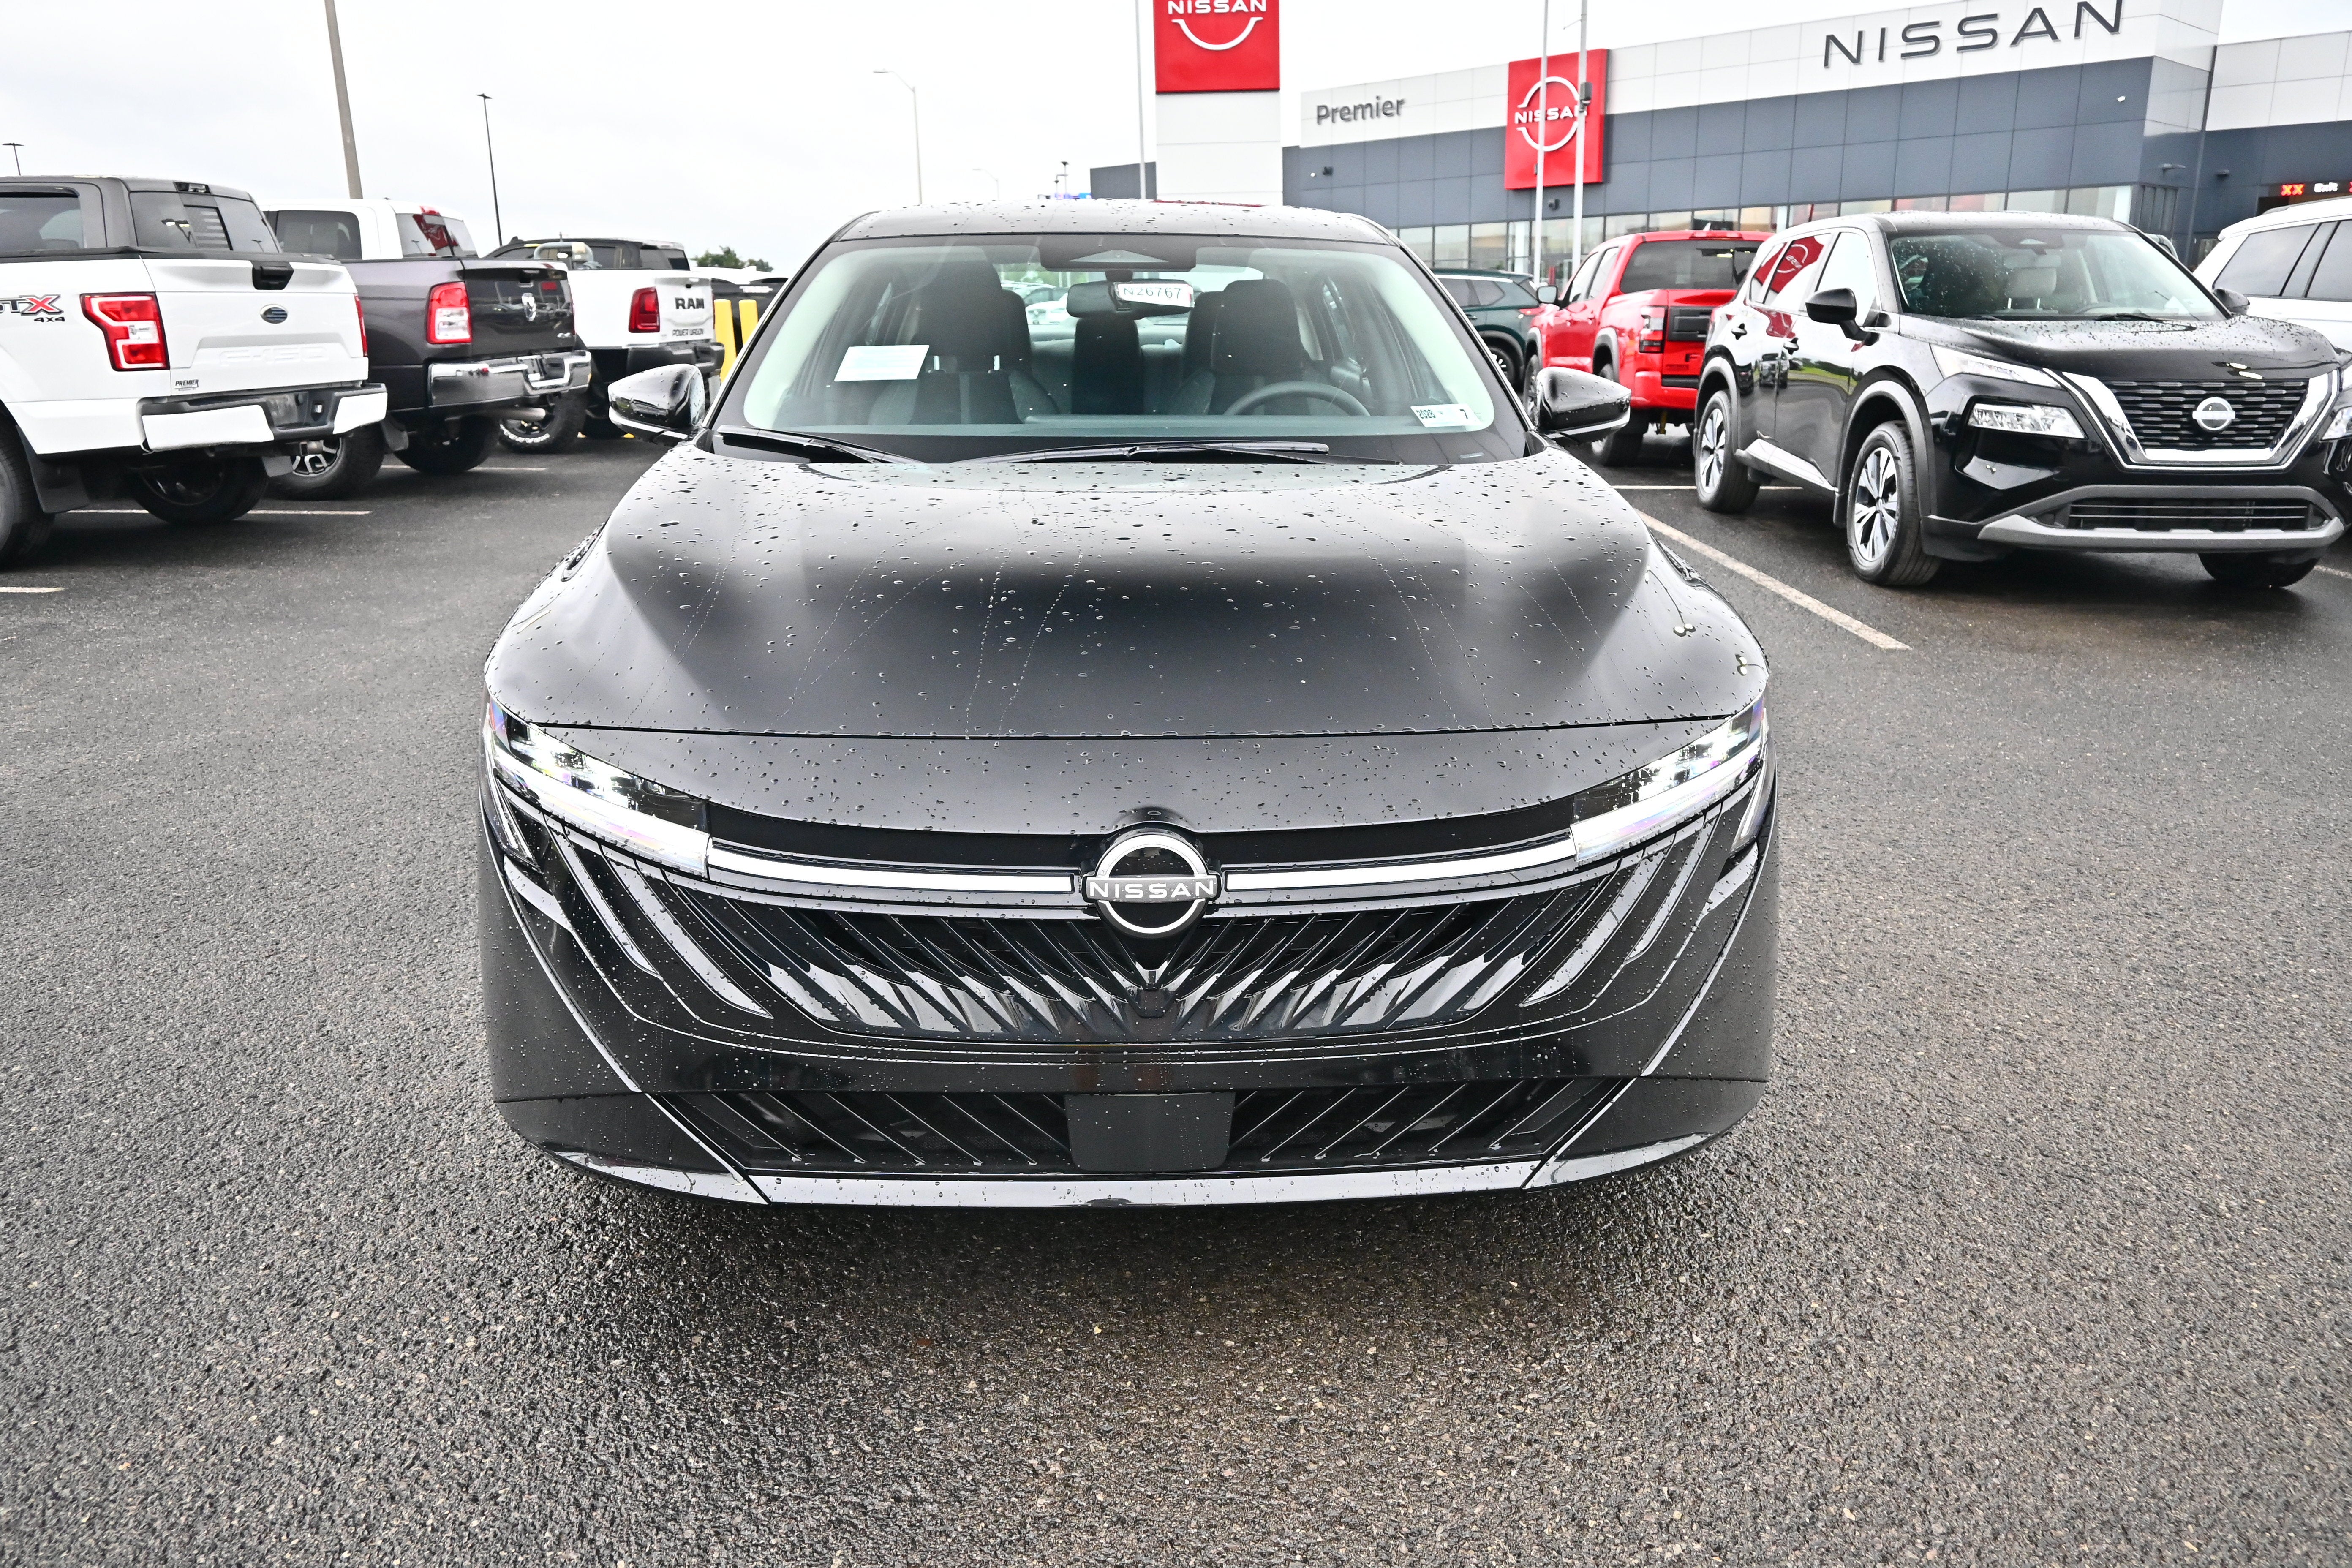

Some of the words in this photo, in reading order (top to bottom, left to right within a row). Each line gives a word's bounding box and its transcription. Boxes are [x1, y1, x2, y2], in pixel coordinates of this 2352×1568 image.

[1168, 0, 1267, 14] NISSAN
[1824, 0, 2123, 68] NISSAN
[1317, 95, 1405, 125] Premier
[1123, 287, 1181, 299] N26767
[0, 294, 64, 316] TX
[675, 297, 705, 309] RAM
[1416, 409, 1436, 419] 2028
[1459, 409, 1468, 419] 7
[1090, 880, 1214, 898] NISSAN
